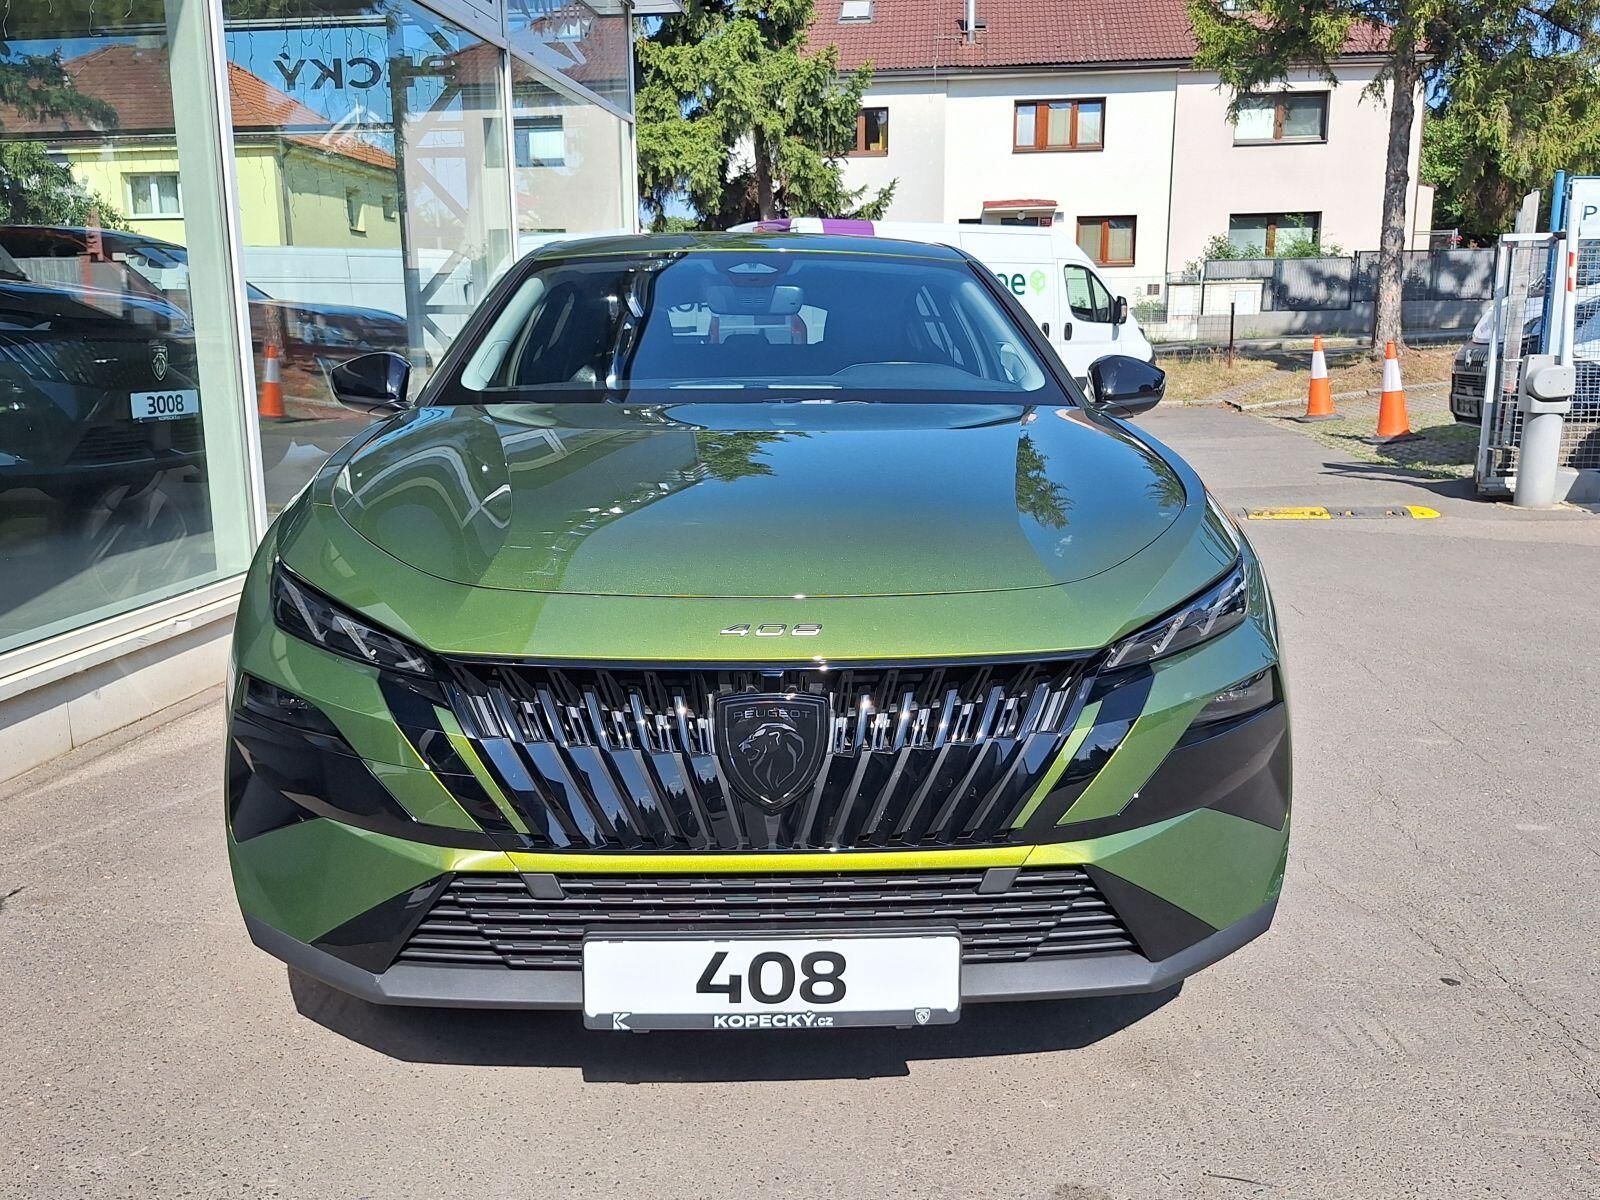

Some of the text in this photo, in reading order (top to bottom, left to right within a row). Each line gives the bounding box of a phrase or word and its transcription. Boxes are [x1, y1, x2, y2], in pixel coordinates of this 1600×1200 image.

[146, 394, 185, 415] 3008
[719, 623, 823, 637] 408
[733, 709, 812, 720] PEUGEOT
[695, 951, 848, 1005] 408
